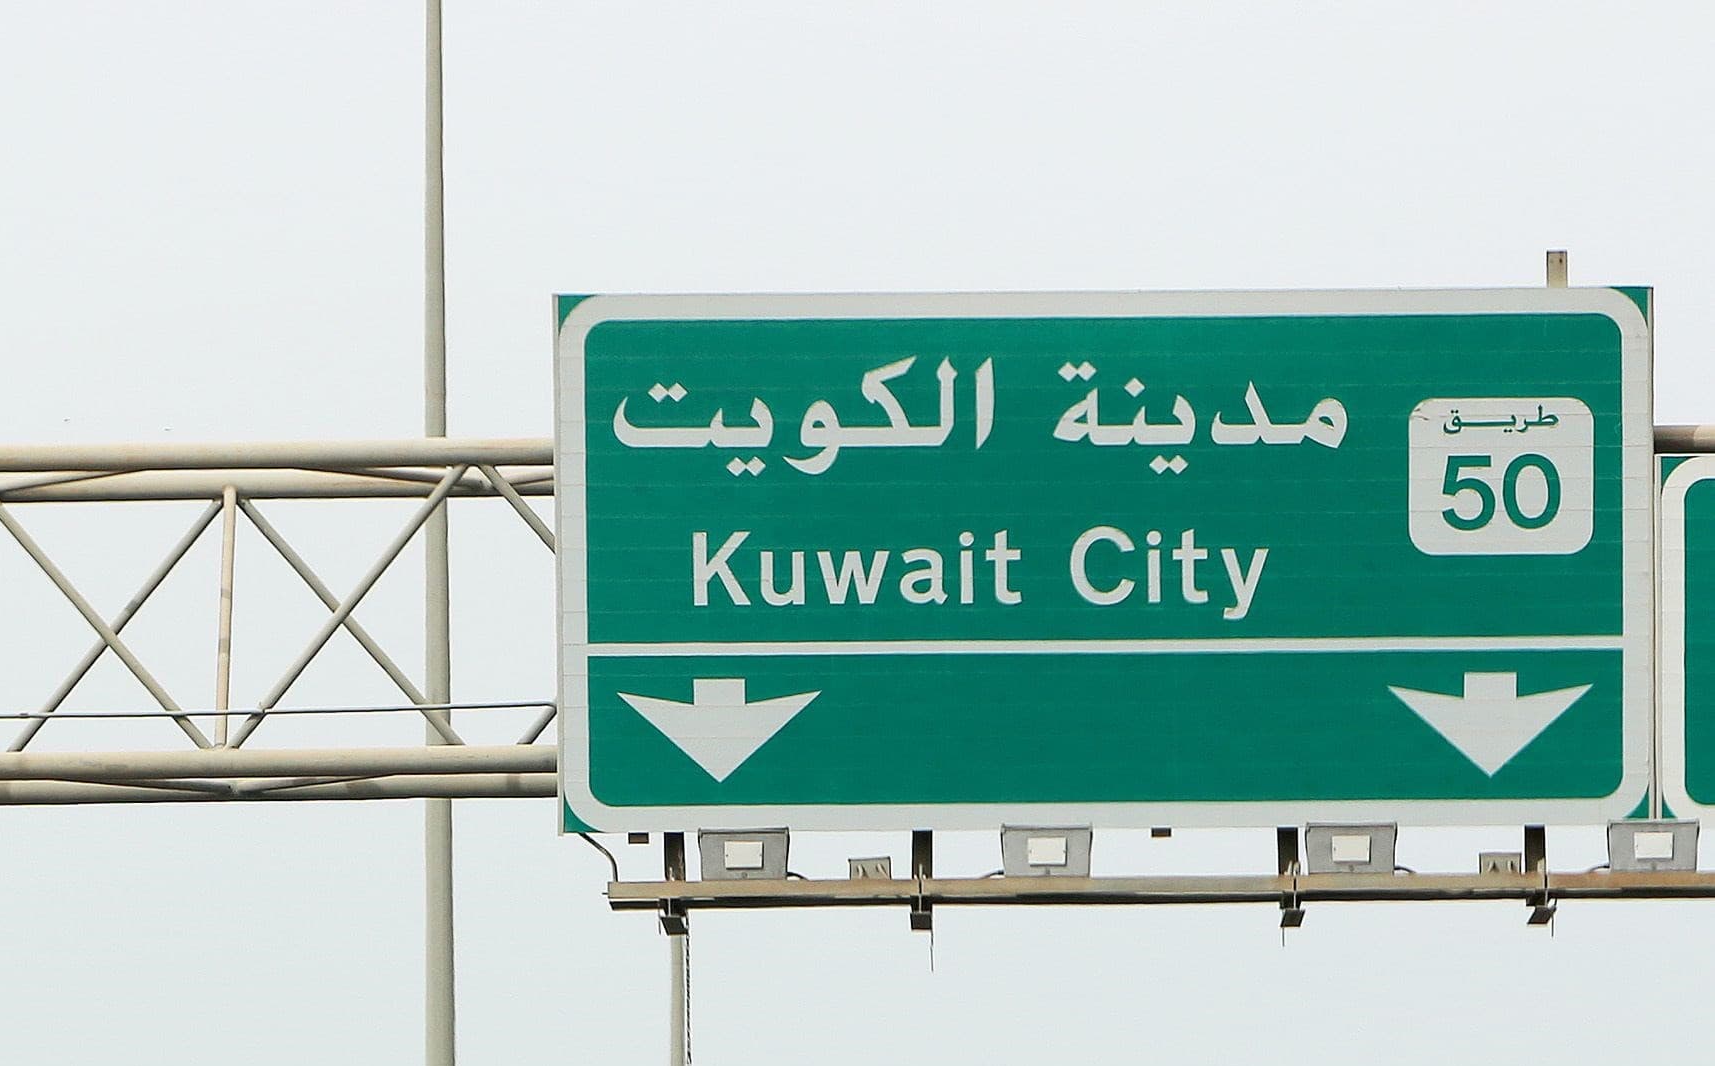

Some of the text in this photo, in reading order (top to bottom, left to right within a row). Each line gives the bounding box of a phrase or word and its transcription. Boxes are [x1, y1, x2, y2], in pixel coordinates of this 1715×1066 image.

[612, 355, 1349, 478] مدينة الكويت
[1441, 453, 1562, 531] 50
[691, 525, 1270, 621] Kuwait City
